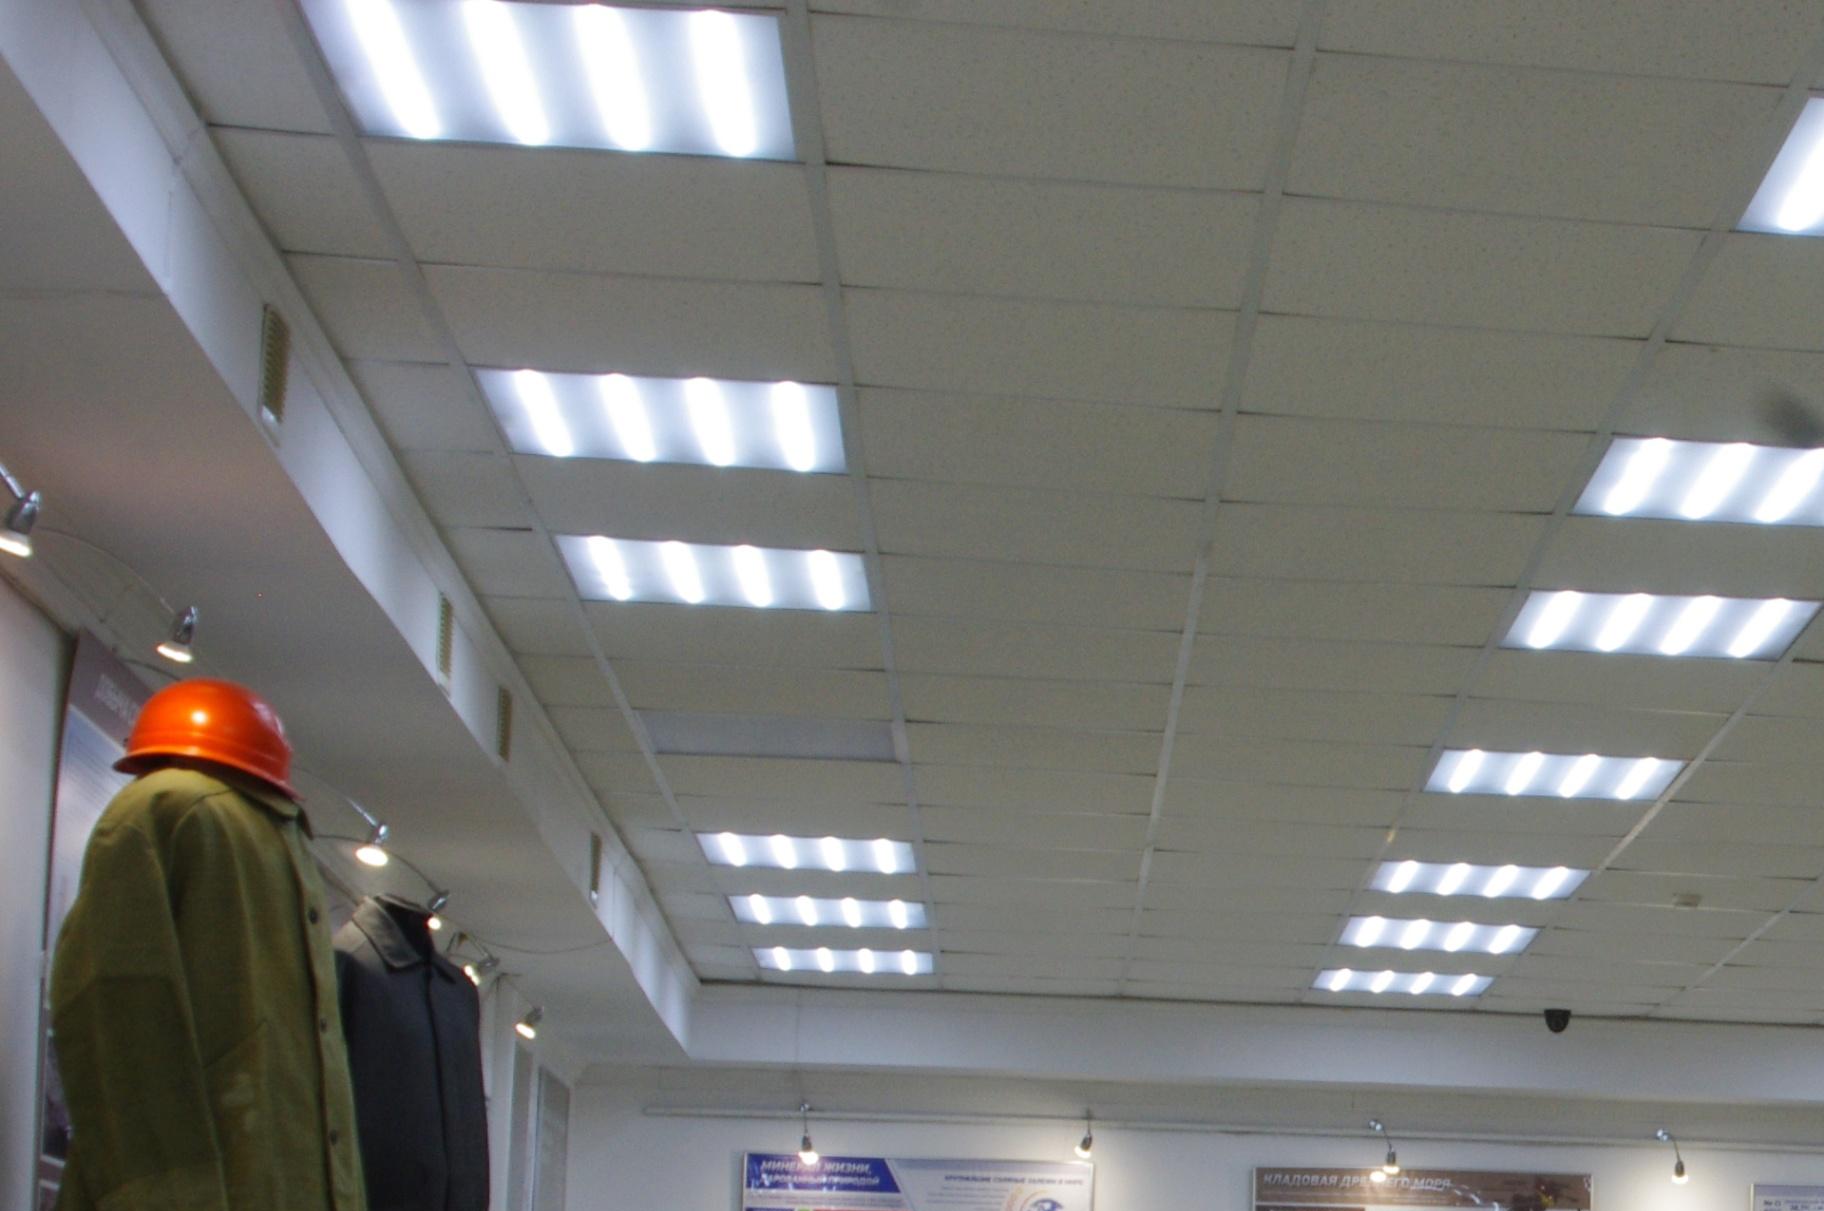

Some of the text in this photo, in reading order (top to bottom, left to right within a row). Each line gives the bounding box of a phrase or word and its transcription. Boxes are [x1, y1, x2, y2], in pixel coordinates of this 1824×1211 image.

[761, 1160, 821, 1174] МИНЕРЛ
[1263, 1174, 1452, 1188] КЛАДОВАЯ ДРЕЕГО МОРЯ
